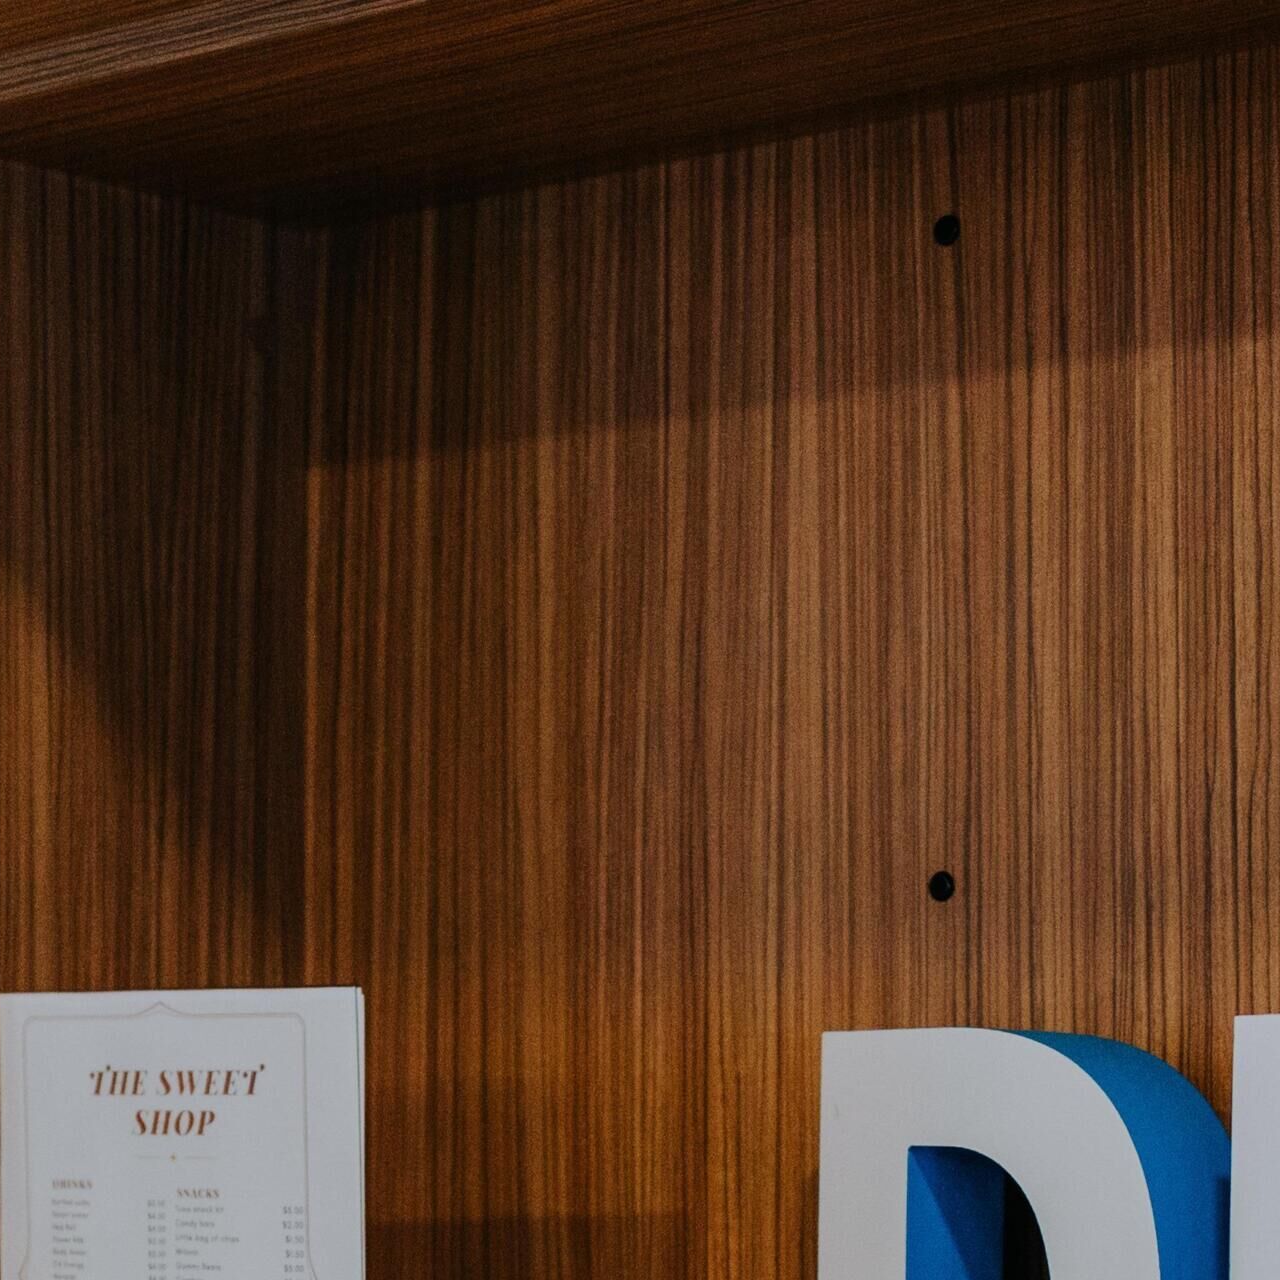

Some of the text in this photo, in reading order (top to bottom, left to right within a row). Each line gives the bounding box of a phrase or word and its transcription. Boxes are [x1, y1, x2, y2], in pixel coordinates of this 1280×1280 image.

[89, 1063, 266, 1096] THE SWEET
[131, 1109, 216, 1136] SHOP
[175, 1188, 221, 1200] SNACKS
